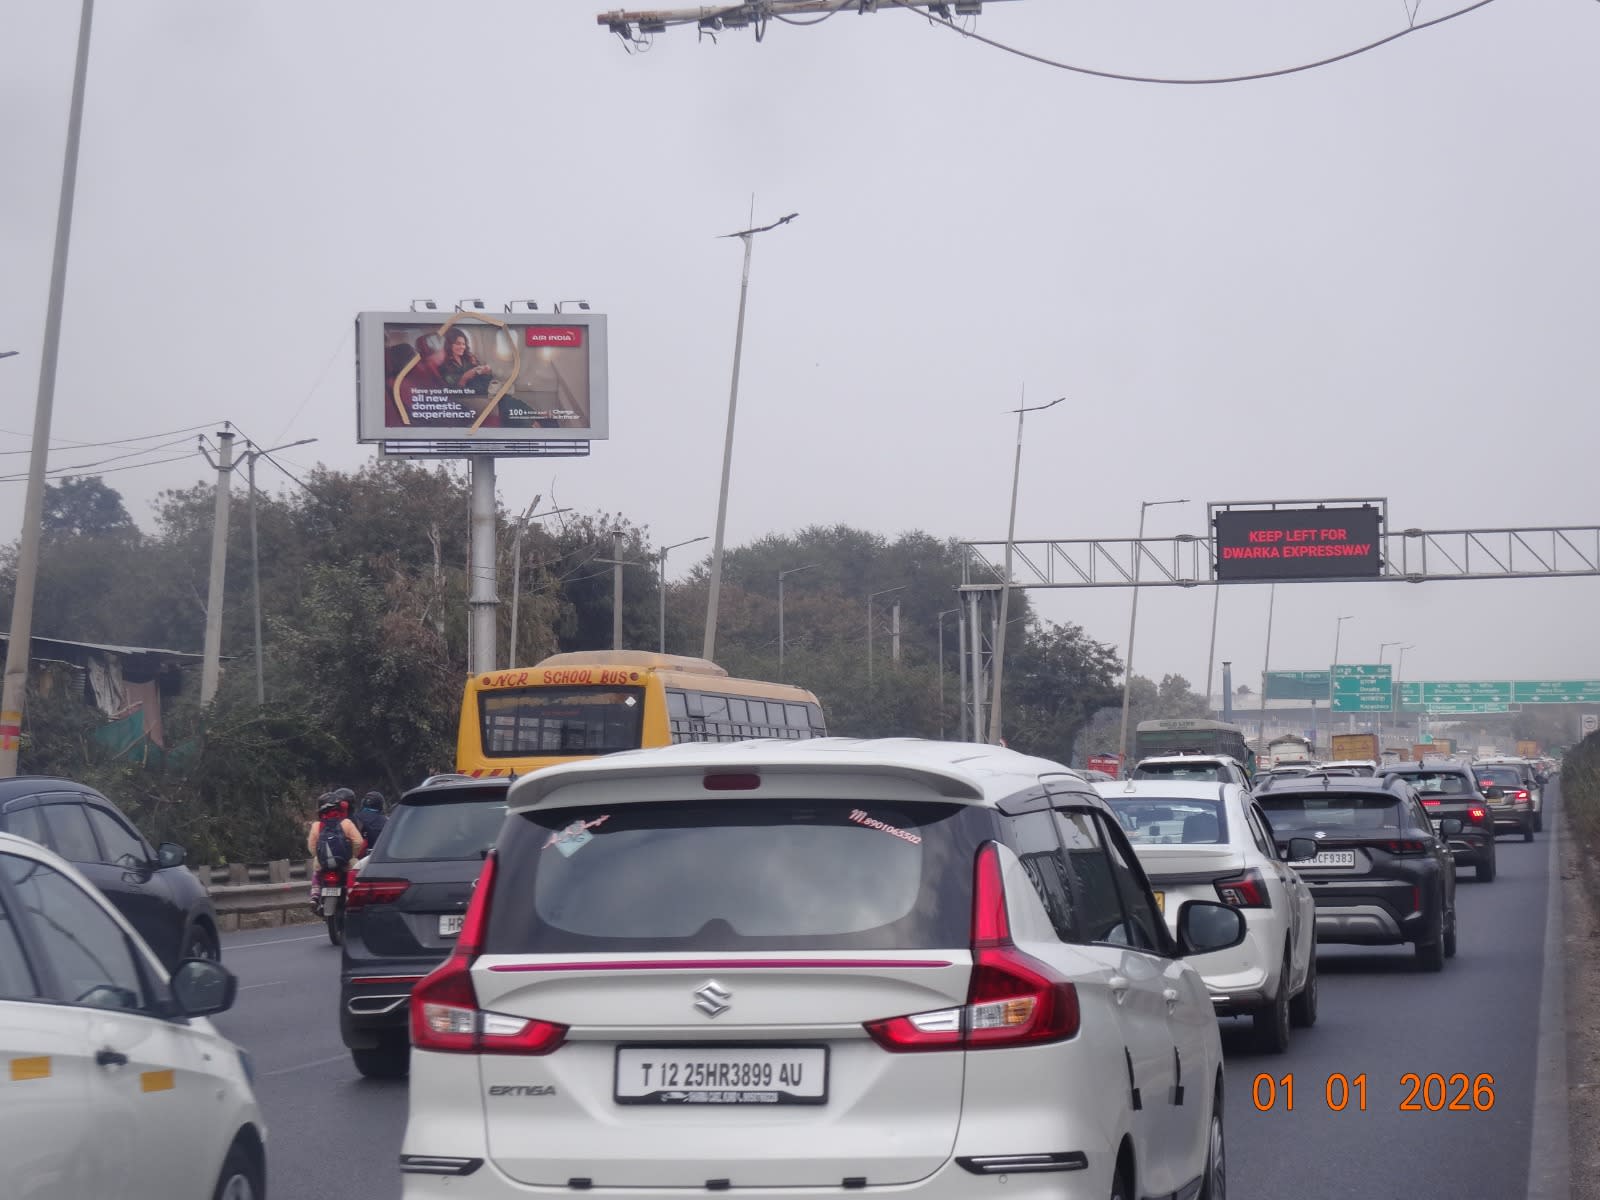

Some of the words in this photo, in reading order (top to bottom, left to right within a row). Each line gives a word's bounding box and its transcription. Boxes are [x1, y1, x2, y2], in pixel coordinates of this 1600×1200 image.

[411, 394, 424, 402] all
[411, 402, 462, 410] domestic
[412, 410, 476, 420] experience?
[1248, 530, 1283, 543] KEEP
[1286, 529, 1317, 542] LEFT
[1321, 528, 1347, 541] FOR
[1223, 546, 1280, 559] DWARKA
[1282, 544, 1371, 558] EXPRESSWAY
[491, 672, 528, 688] NCR
[543, 669, 593, 684] SCHOOL
[600, 668, 628, 684] BUS
[642, 1063, 652, 1086] T
[660, 1063, 678, 1087] 12
[684, 1062, 772, 1087] 25HR3899
[488, 1085, 557, 1097] ERTIGA
